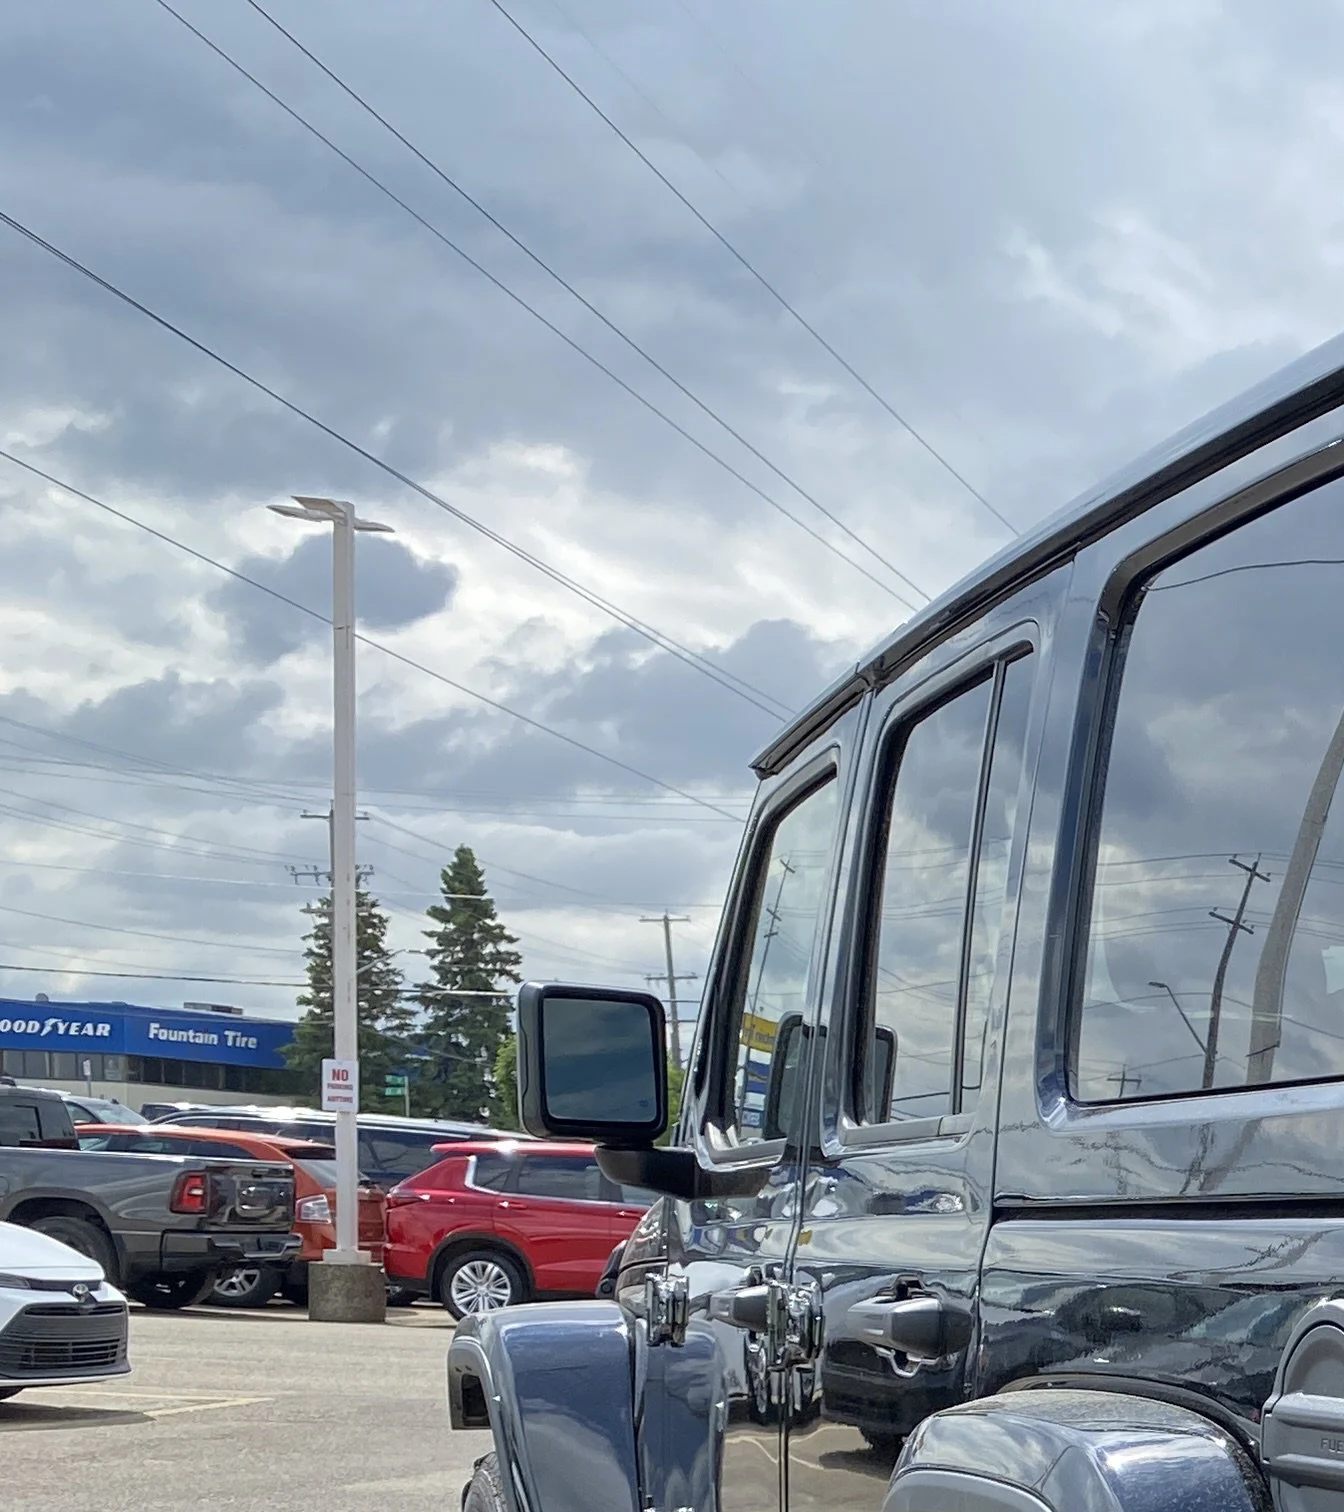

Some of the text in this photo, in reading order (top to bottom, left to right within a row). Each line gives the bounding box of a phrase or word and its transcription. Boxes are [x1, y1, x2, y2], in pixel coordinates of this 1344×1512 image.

[148, 1022, 258, 1050] Fountain Tire
[331, 1068, 349, 1082] NO
